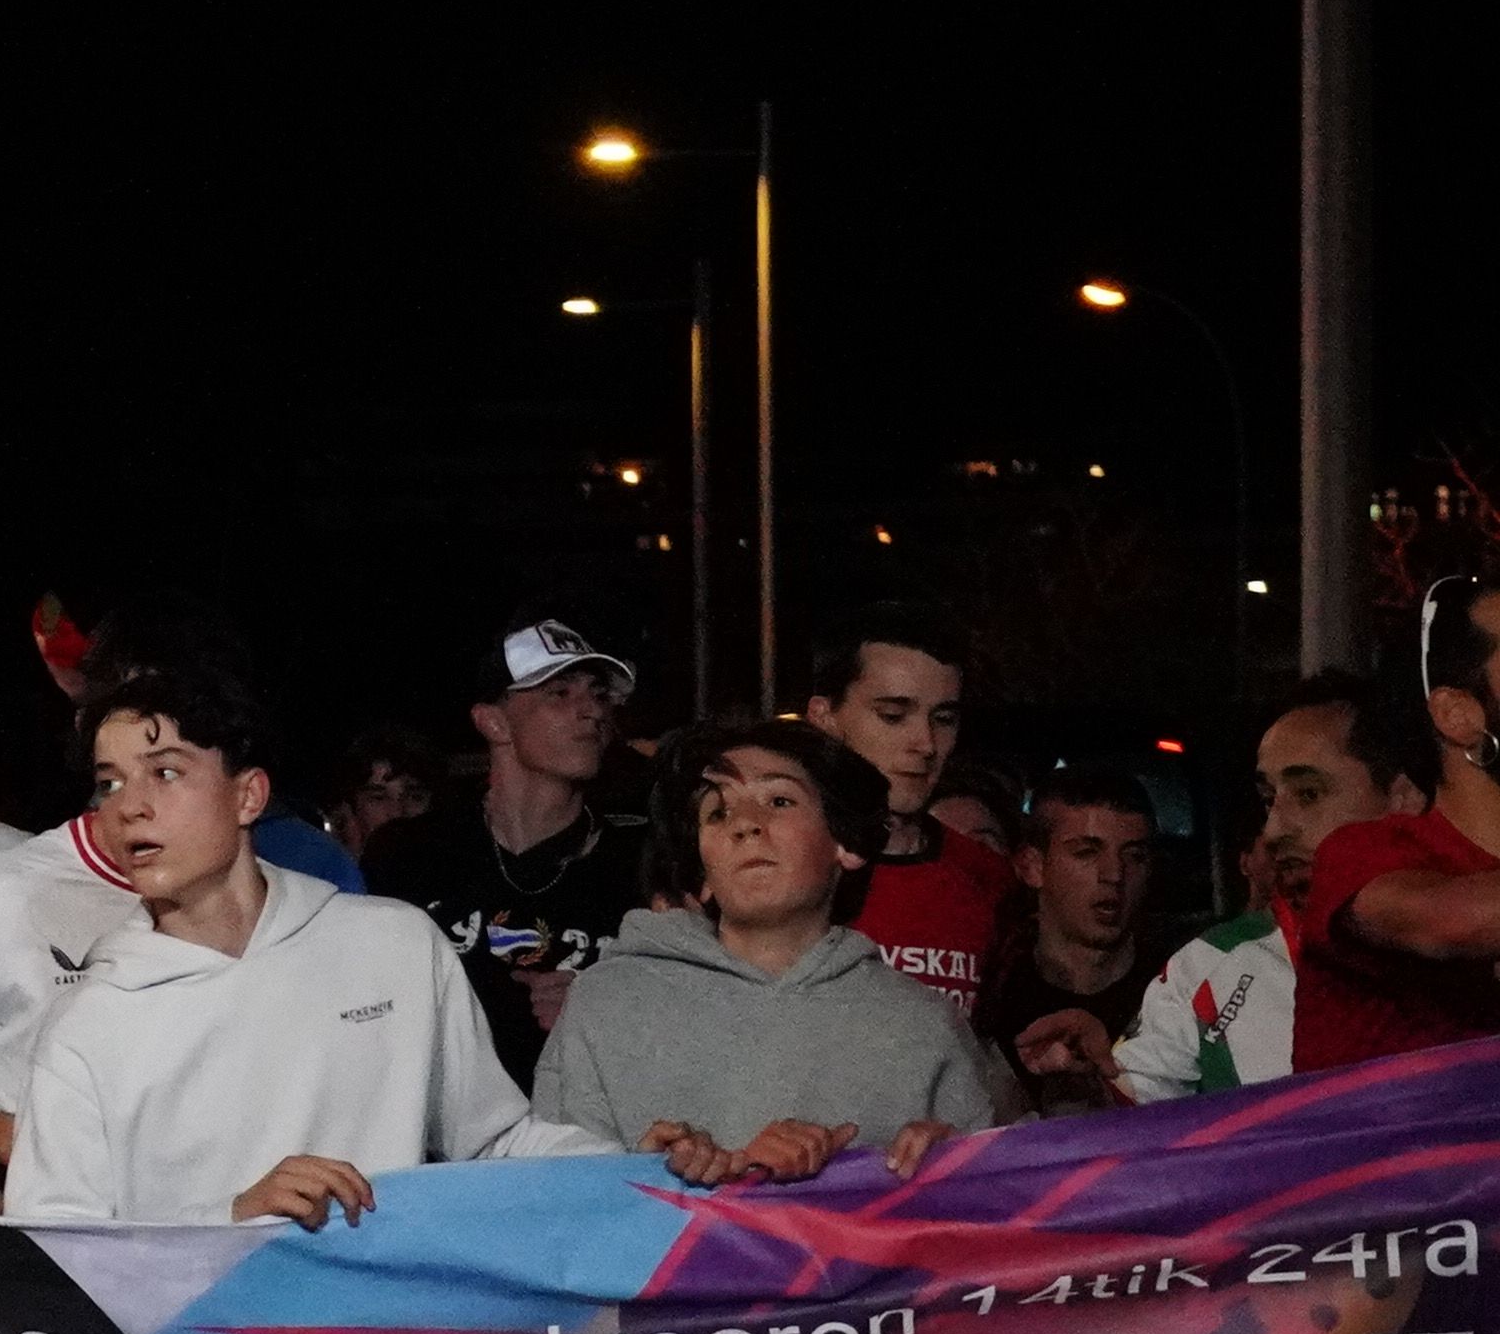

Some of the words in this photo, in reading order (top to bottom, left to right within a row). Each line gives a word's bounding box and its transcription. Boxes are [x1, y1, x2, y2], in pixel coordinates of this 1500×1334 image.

[877, 944, 982, 984] VSKAL
[1203, 973, 1254, 1045] Kappa
[961, 1258, 1210, 1315] 14tik
[1248, 1219, 1479, 1284] 24ra
